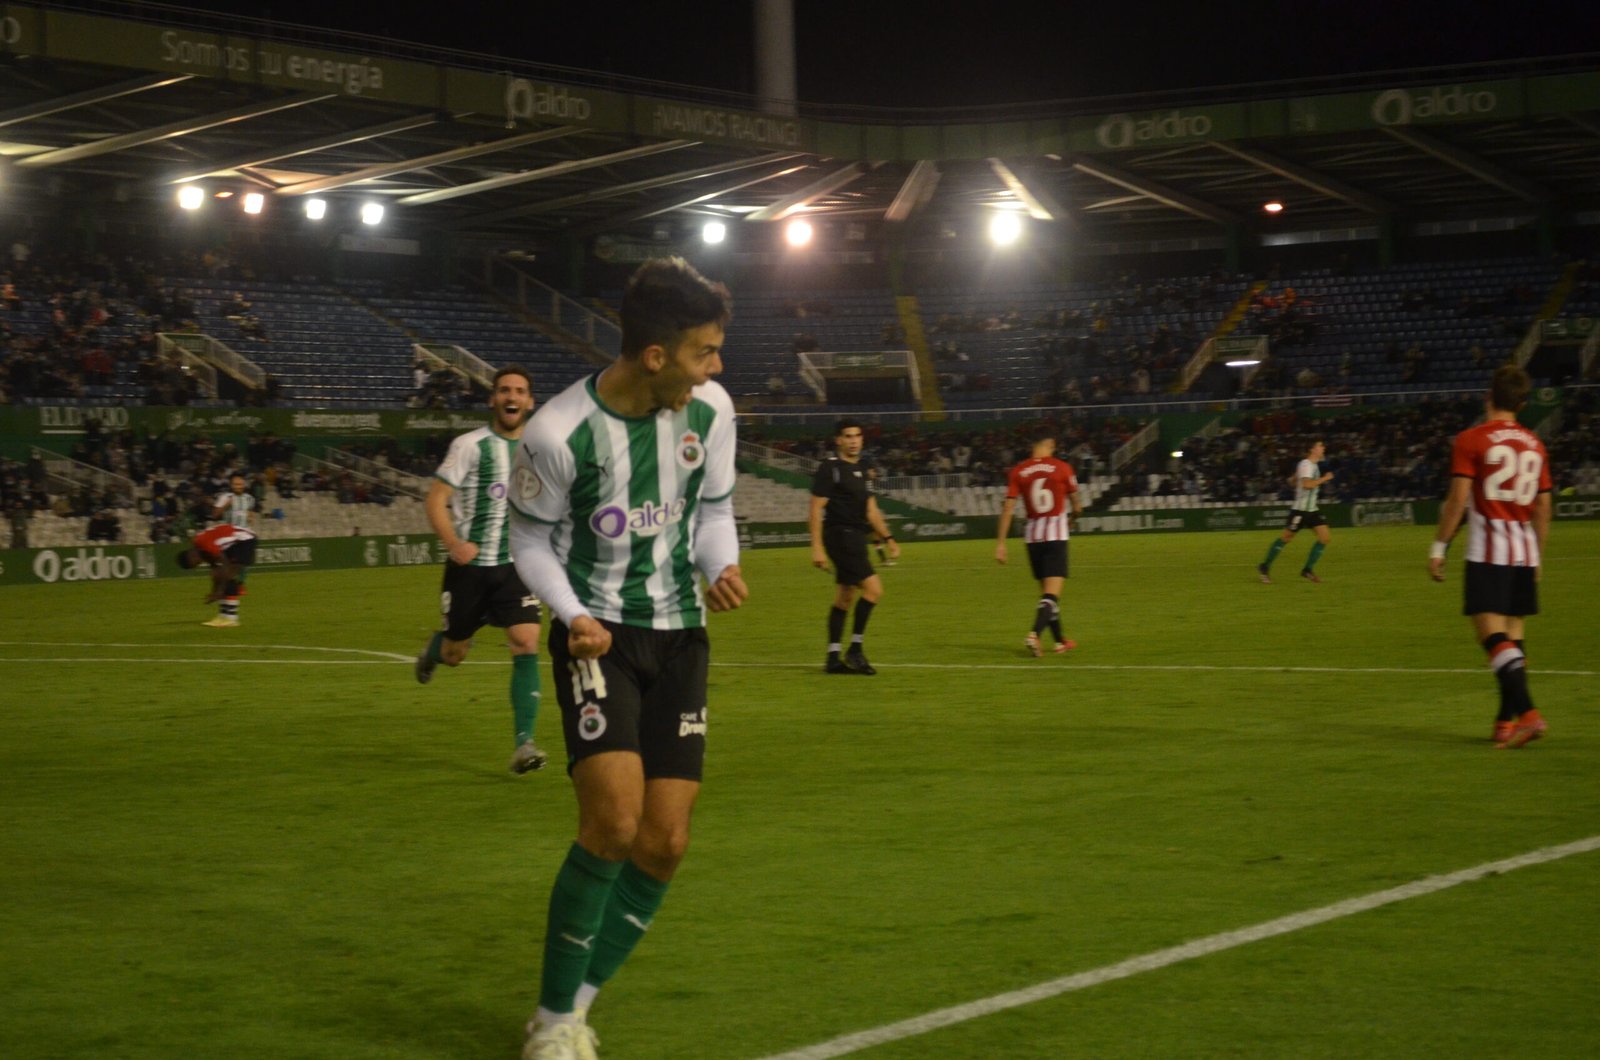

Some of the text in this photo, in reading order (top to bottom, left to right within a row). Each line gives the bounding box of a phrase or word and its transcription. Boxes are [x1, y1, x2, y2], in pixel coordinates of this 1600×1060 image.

[160, 31, 249, 71] Somos
[286, 57, 384, 95] energía
[534, 85, 591, 121] aldro
[1414, 86, 1496, 117] aldro
[1135, 110, 1212, 142] aldro
[1483, 445, 1543, 506] 28
[1030, 478, 1055, 514] 6
[62, 547, 133, 582] aldro
